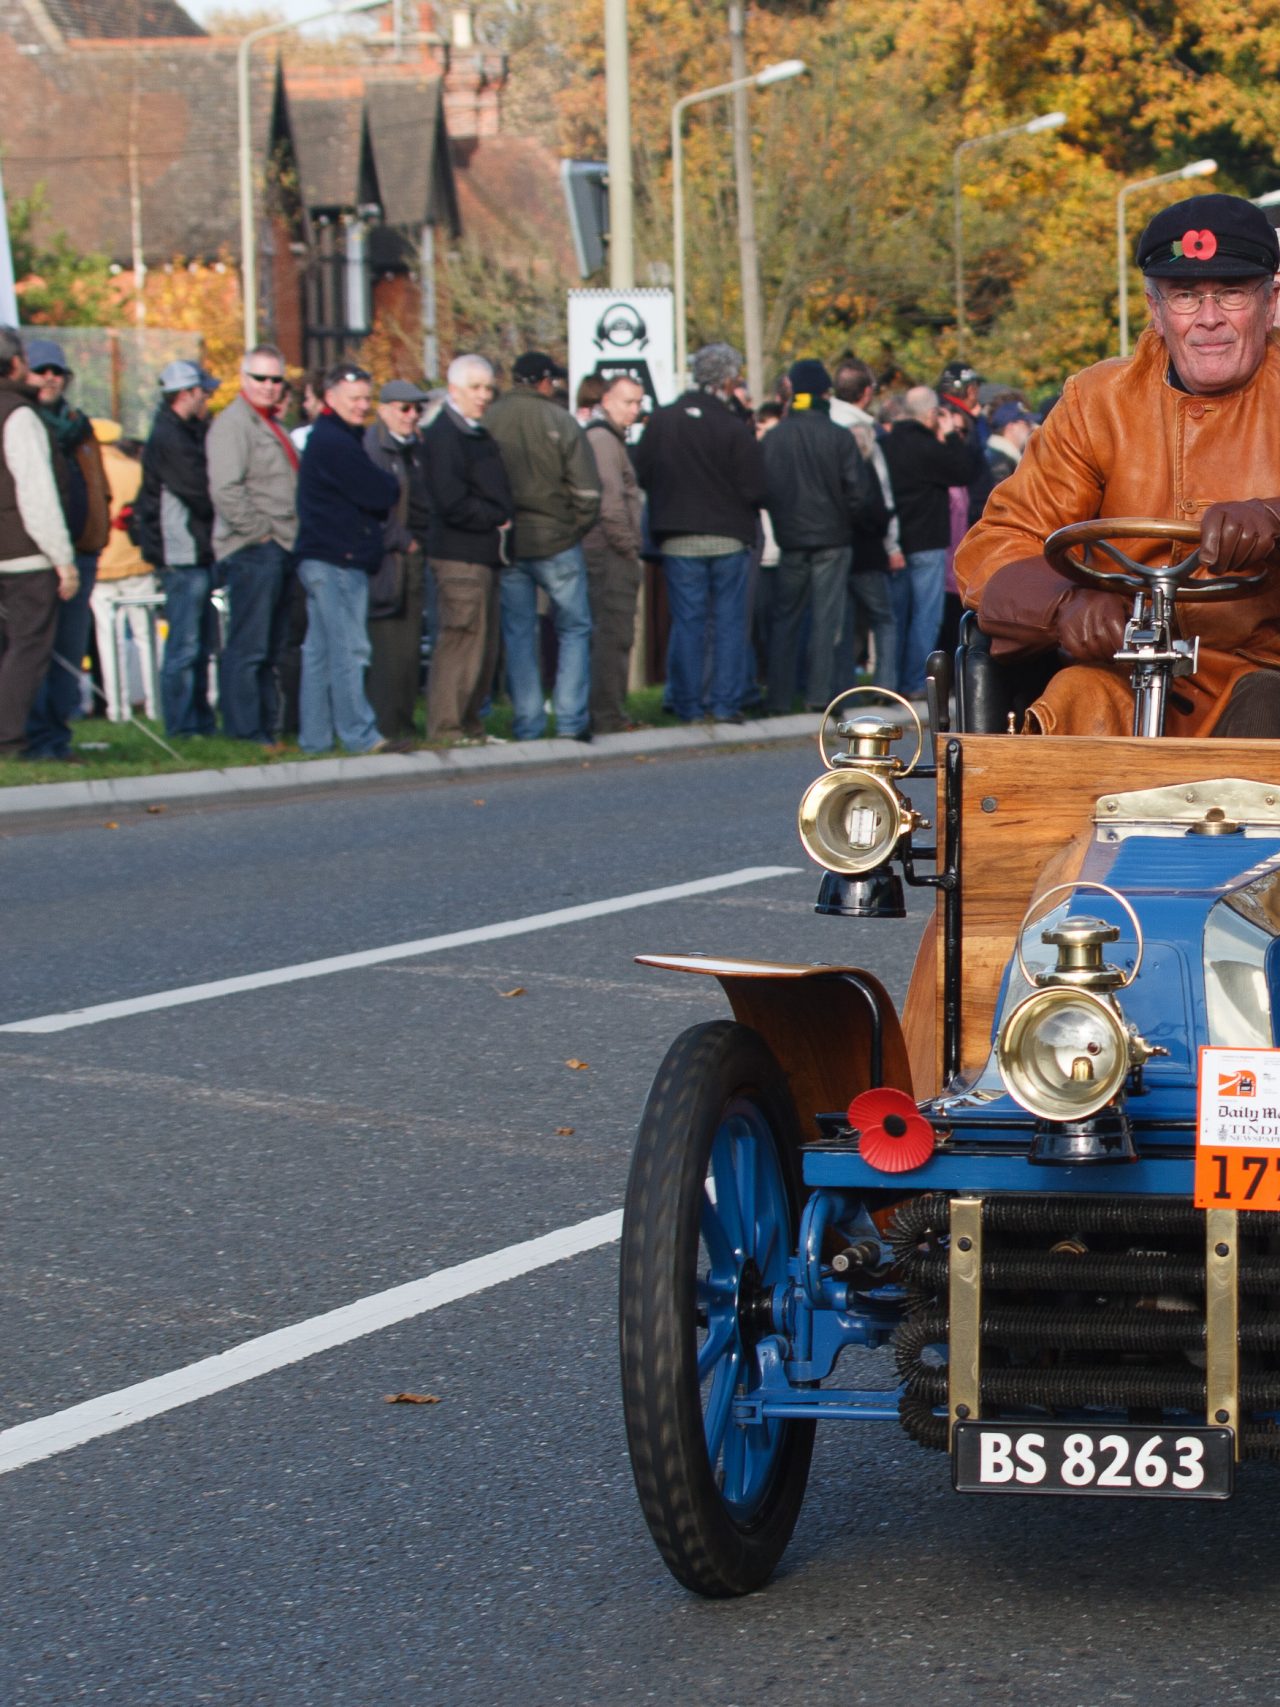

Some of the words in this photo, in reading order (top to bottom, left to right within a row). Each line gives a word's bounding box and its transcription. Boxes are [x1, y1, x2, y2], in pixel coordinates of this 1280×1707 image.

[1218, 1105, 1259, 1122] Daily
[980, 1432, 1047, 1484] BS
[1060, 1433, 1205, 1489] 8263
